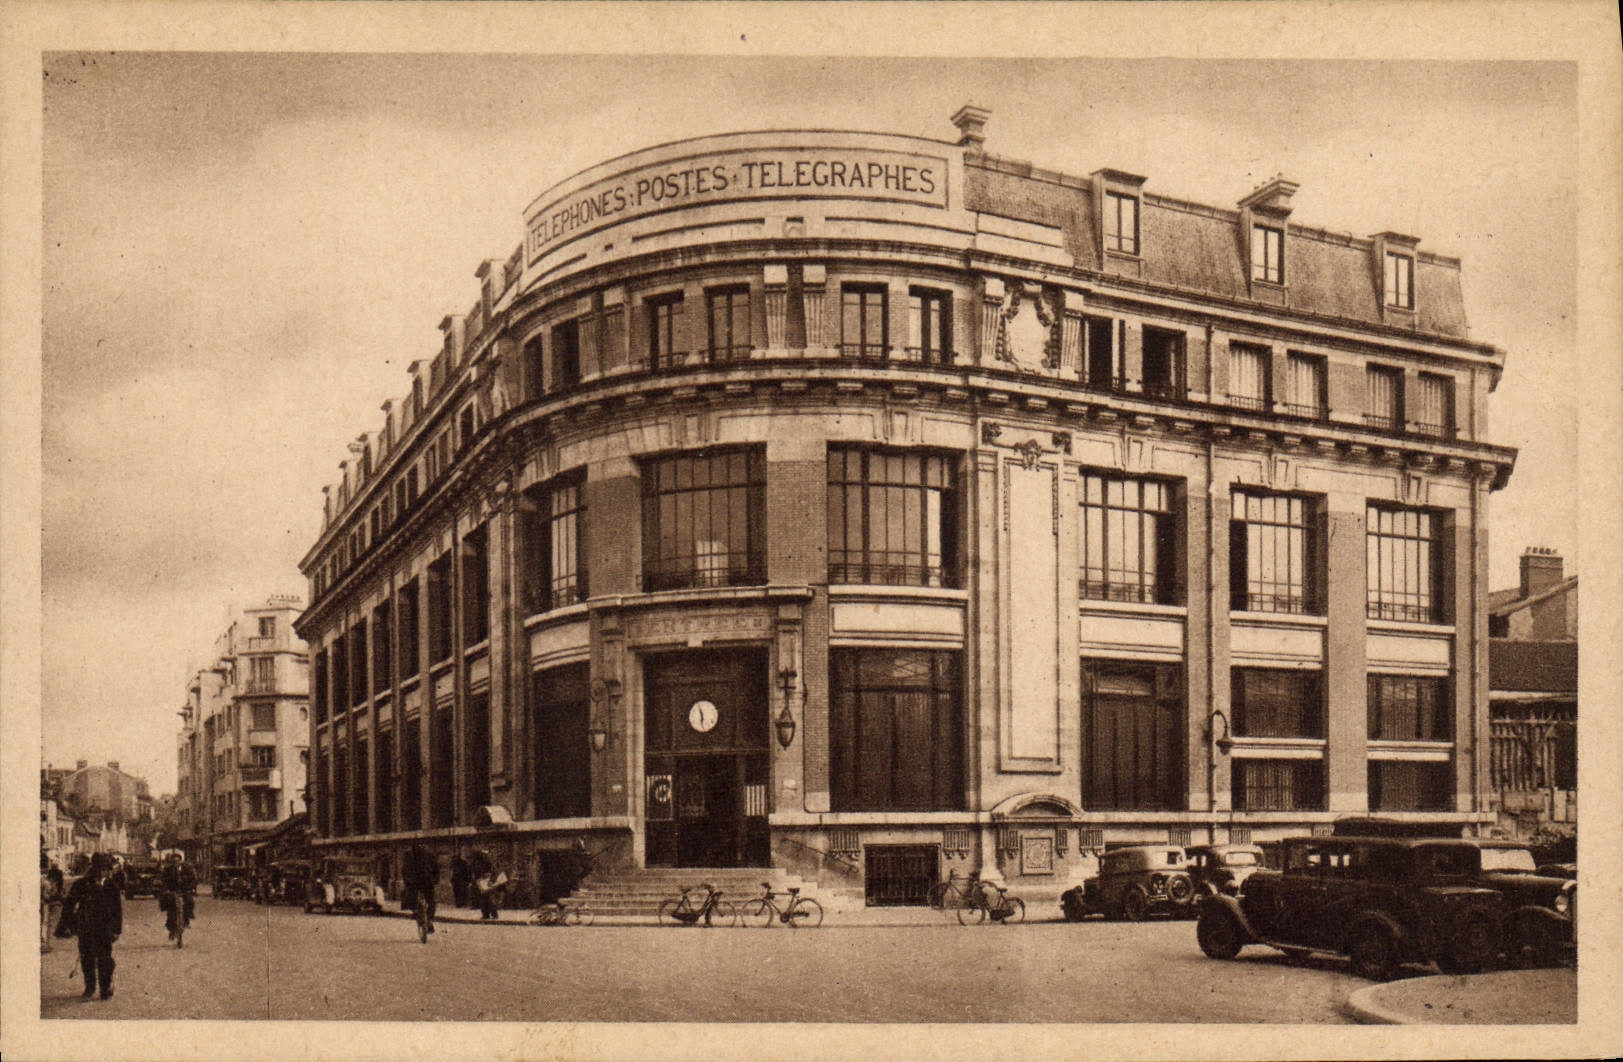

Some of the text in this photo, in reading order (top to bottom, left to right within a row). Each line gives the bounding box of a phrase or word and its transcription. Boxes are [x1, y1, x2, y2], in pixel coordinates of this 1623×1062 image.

[530, 160, 936, 252] TELEPHONES POSTES TELEGRAPHES
